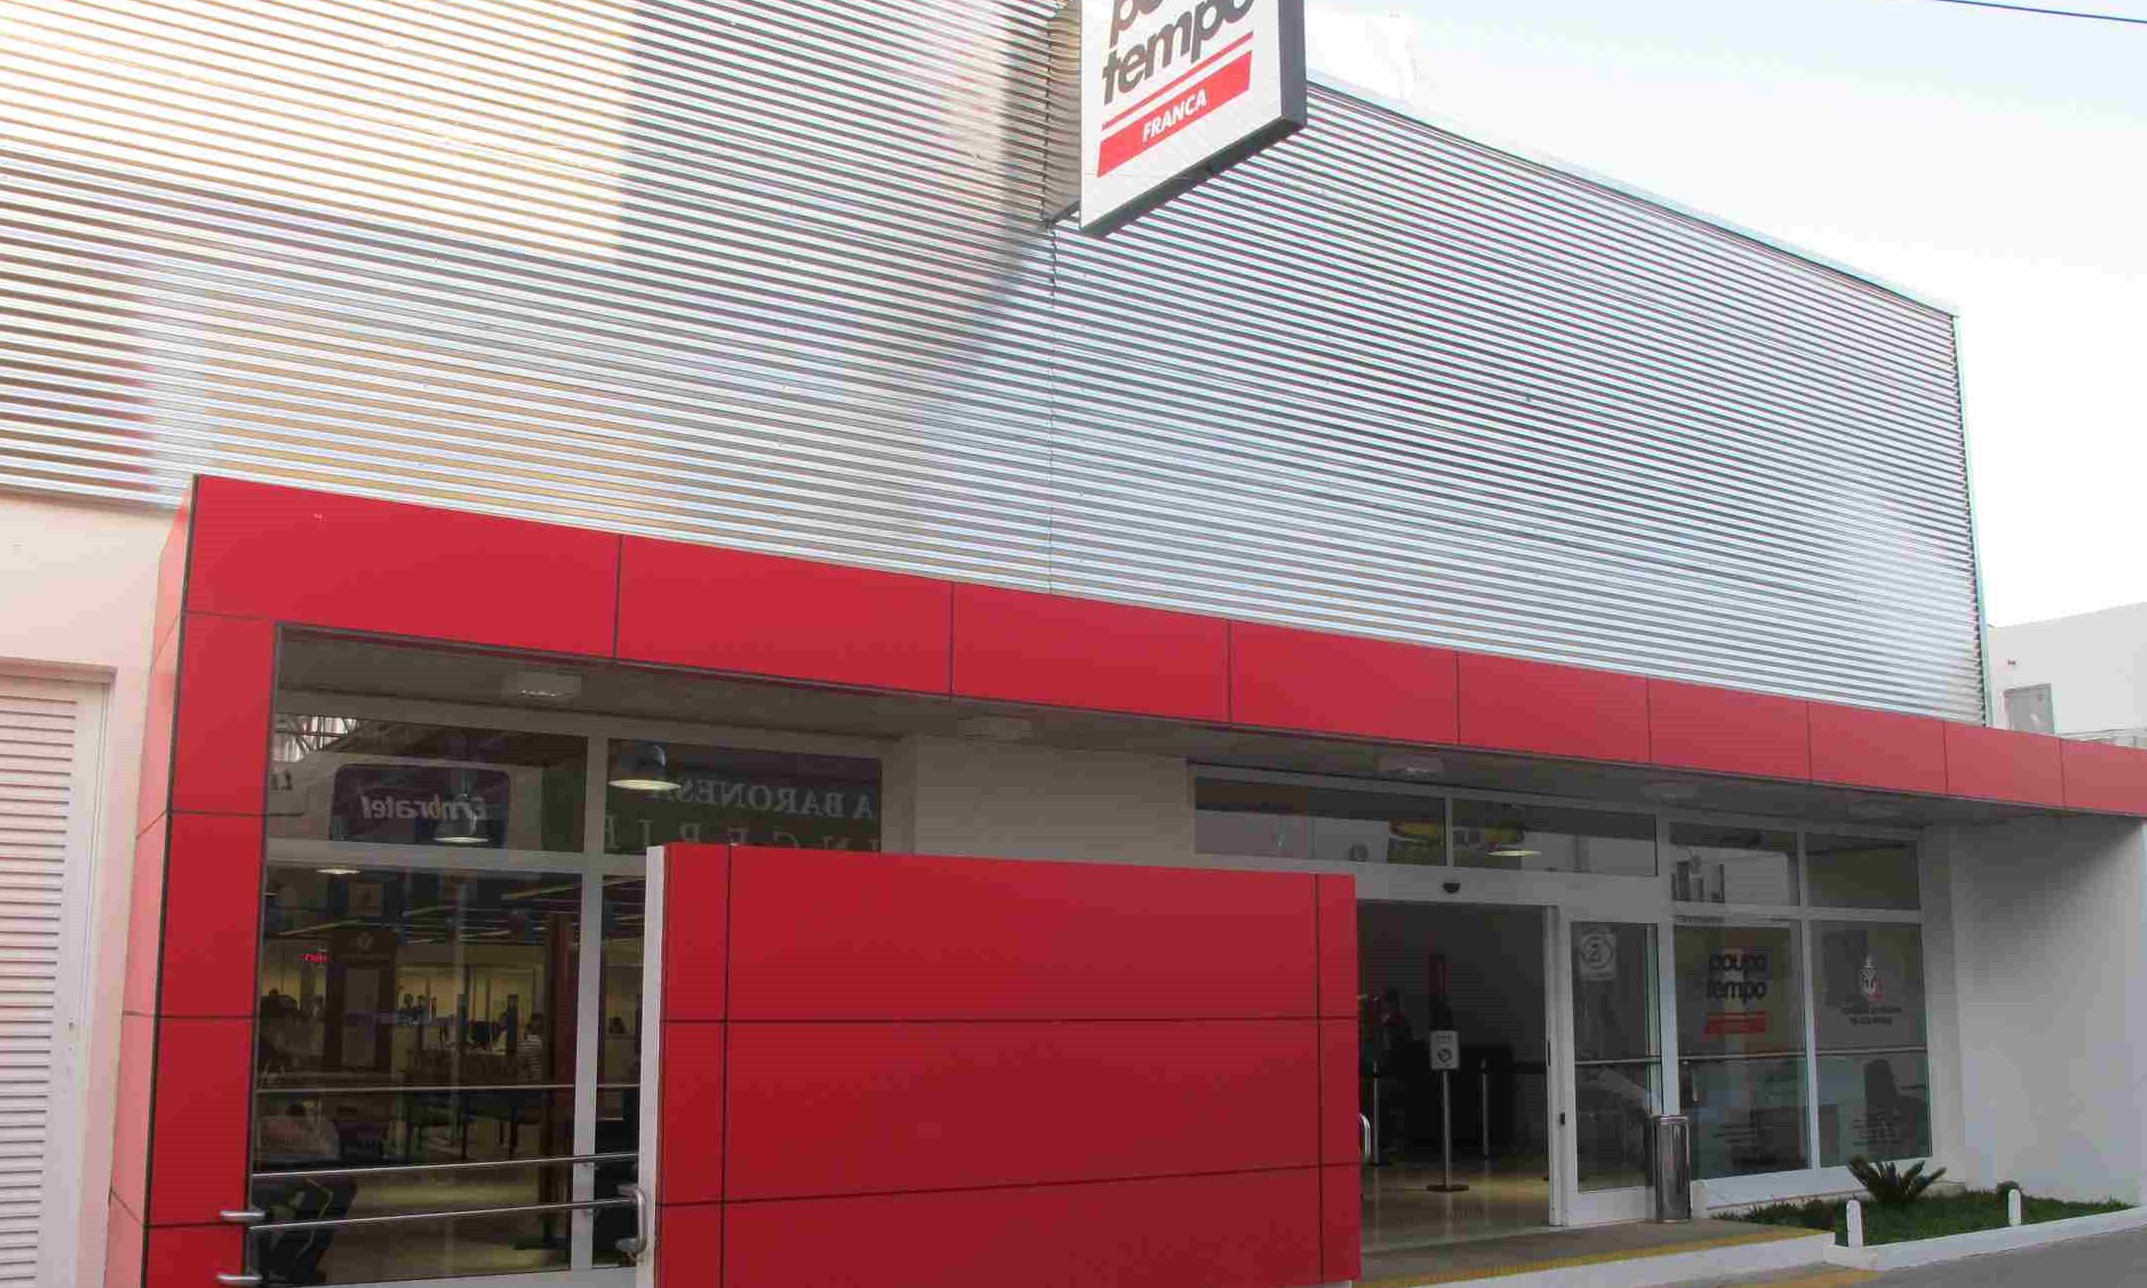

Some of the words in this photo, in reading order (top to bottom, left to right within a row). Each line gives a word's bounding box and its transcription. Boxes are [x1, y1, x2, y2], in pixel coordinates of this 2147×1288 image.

[1102, 0, 1254, 104] tempo
[1142, 89, 1208, 142] FRANCA
[1705, 978, 1768, 1005] tempo
